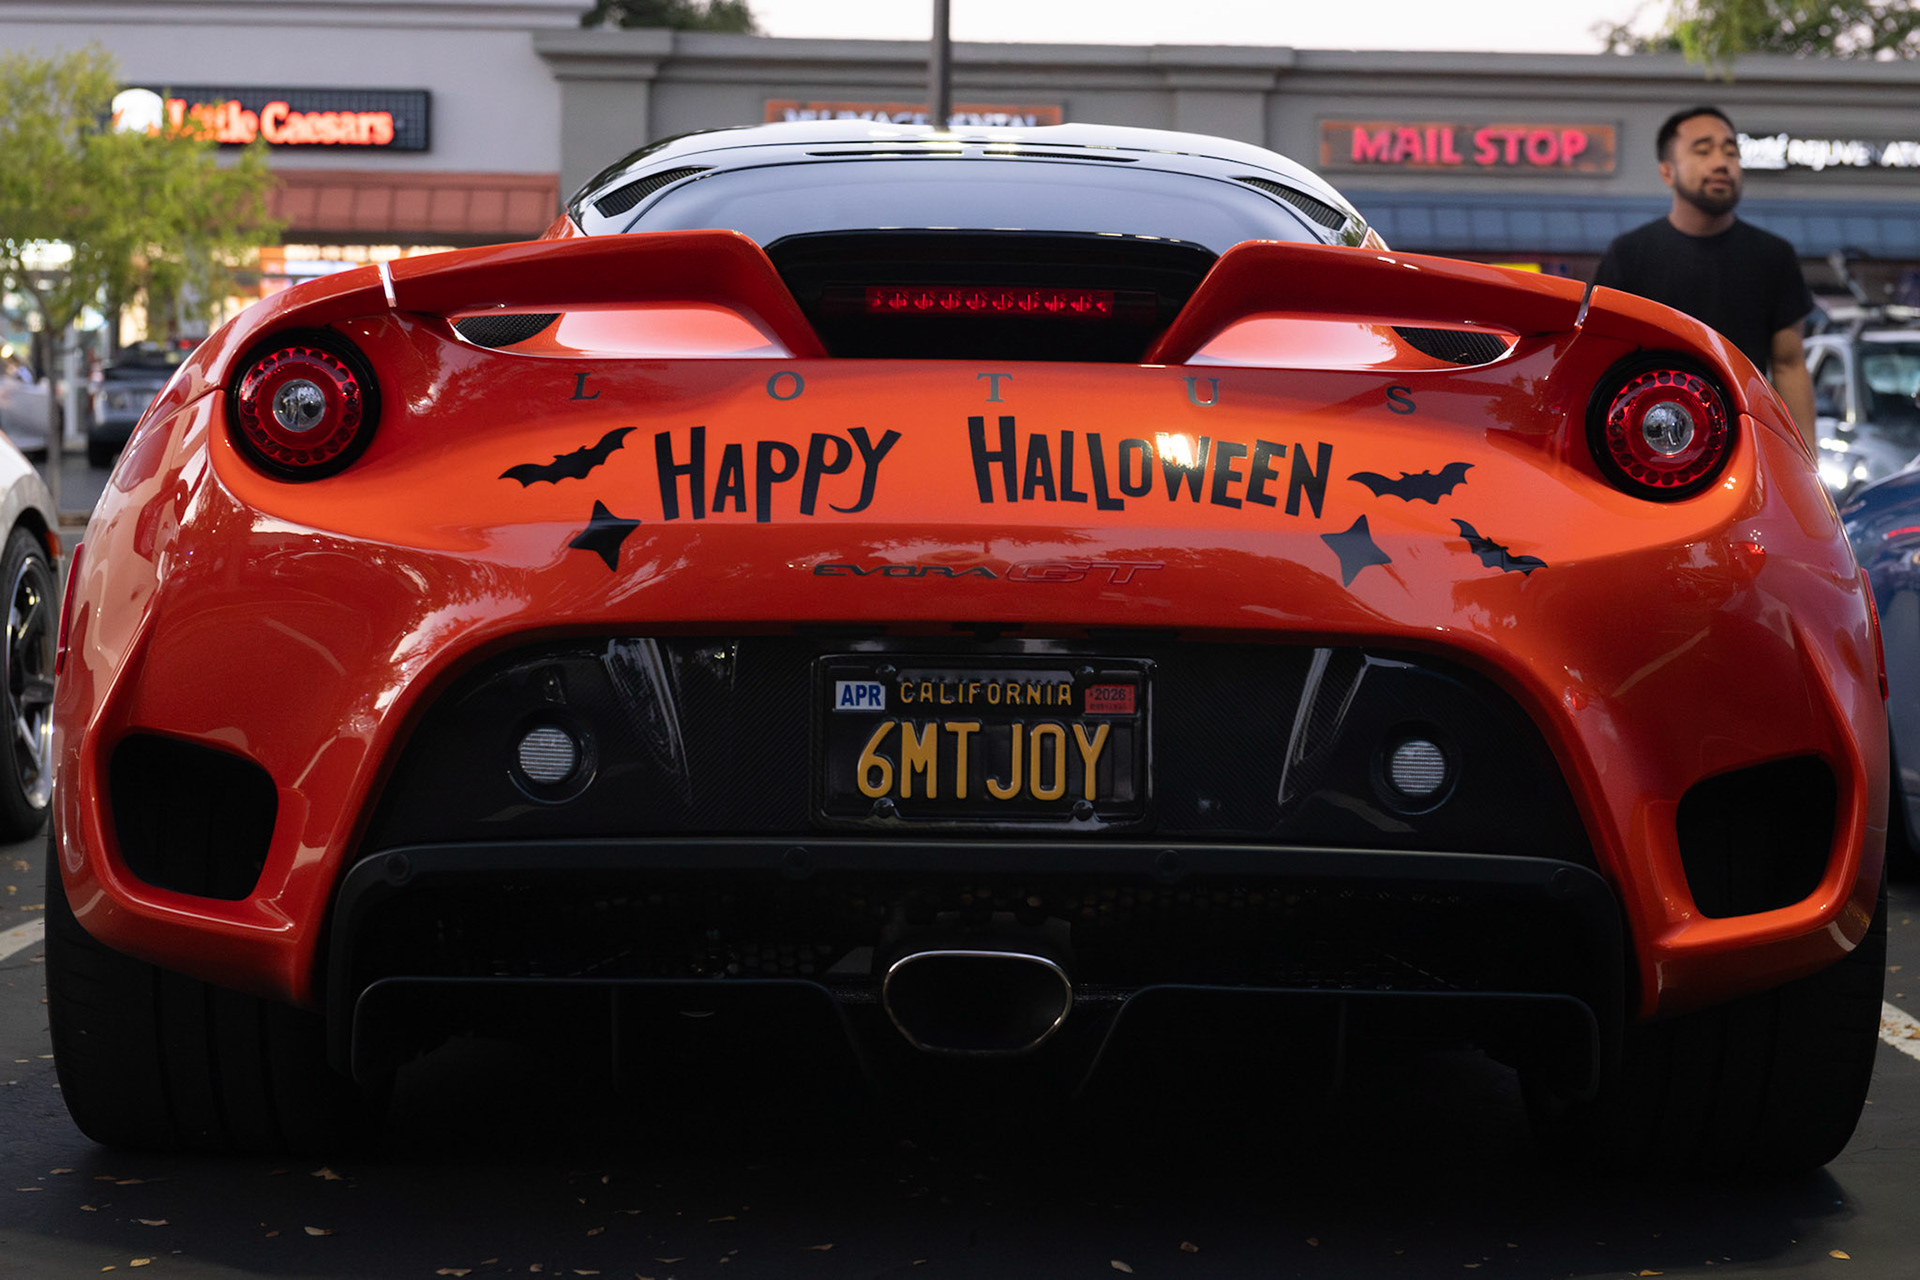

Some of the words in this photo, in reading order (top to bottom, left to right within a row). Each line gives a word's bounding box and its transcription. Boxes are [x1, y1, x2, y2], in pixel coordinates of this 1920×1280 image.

[260, 101, 394, 145] Caesars
[1352, 126, 1462, 164] MAIL
[1473, 128, 1588, 165] STOP
[654, 425, 902, 523] HAPPY
[967, 415, 1333, 519] HALLOWEEN
[813, 563, 998, 579] EVORA
[1005, 559, 1166, 584] GT
[840, 683, 882, 707] APR
[900, 681, 1073, 706] CALIFORNIA
[1094, 687, 1126, 701] 2026
